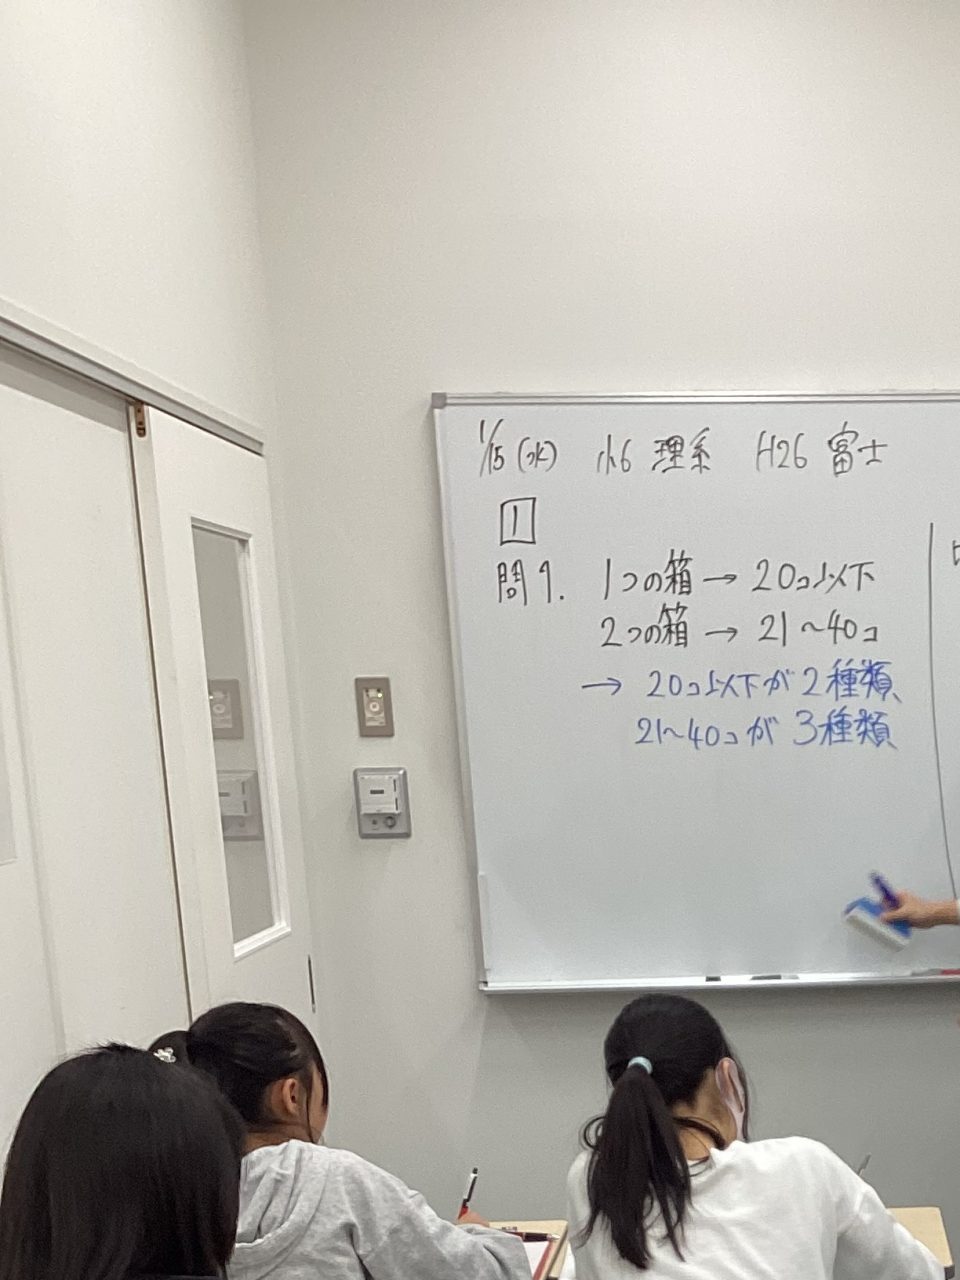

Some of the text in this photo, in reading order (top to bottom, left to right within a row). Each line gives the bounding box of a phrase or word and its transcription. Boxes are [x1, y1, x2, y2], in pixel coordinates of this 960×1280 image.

[651, 426, 711, 474] 理系
[756, 431, 808, 472] H26
[826, 421, 889, 477] 富士
[604, 549, 693, 600] 1つの箱
[600, 602, 689, 648] 2つの箱
